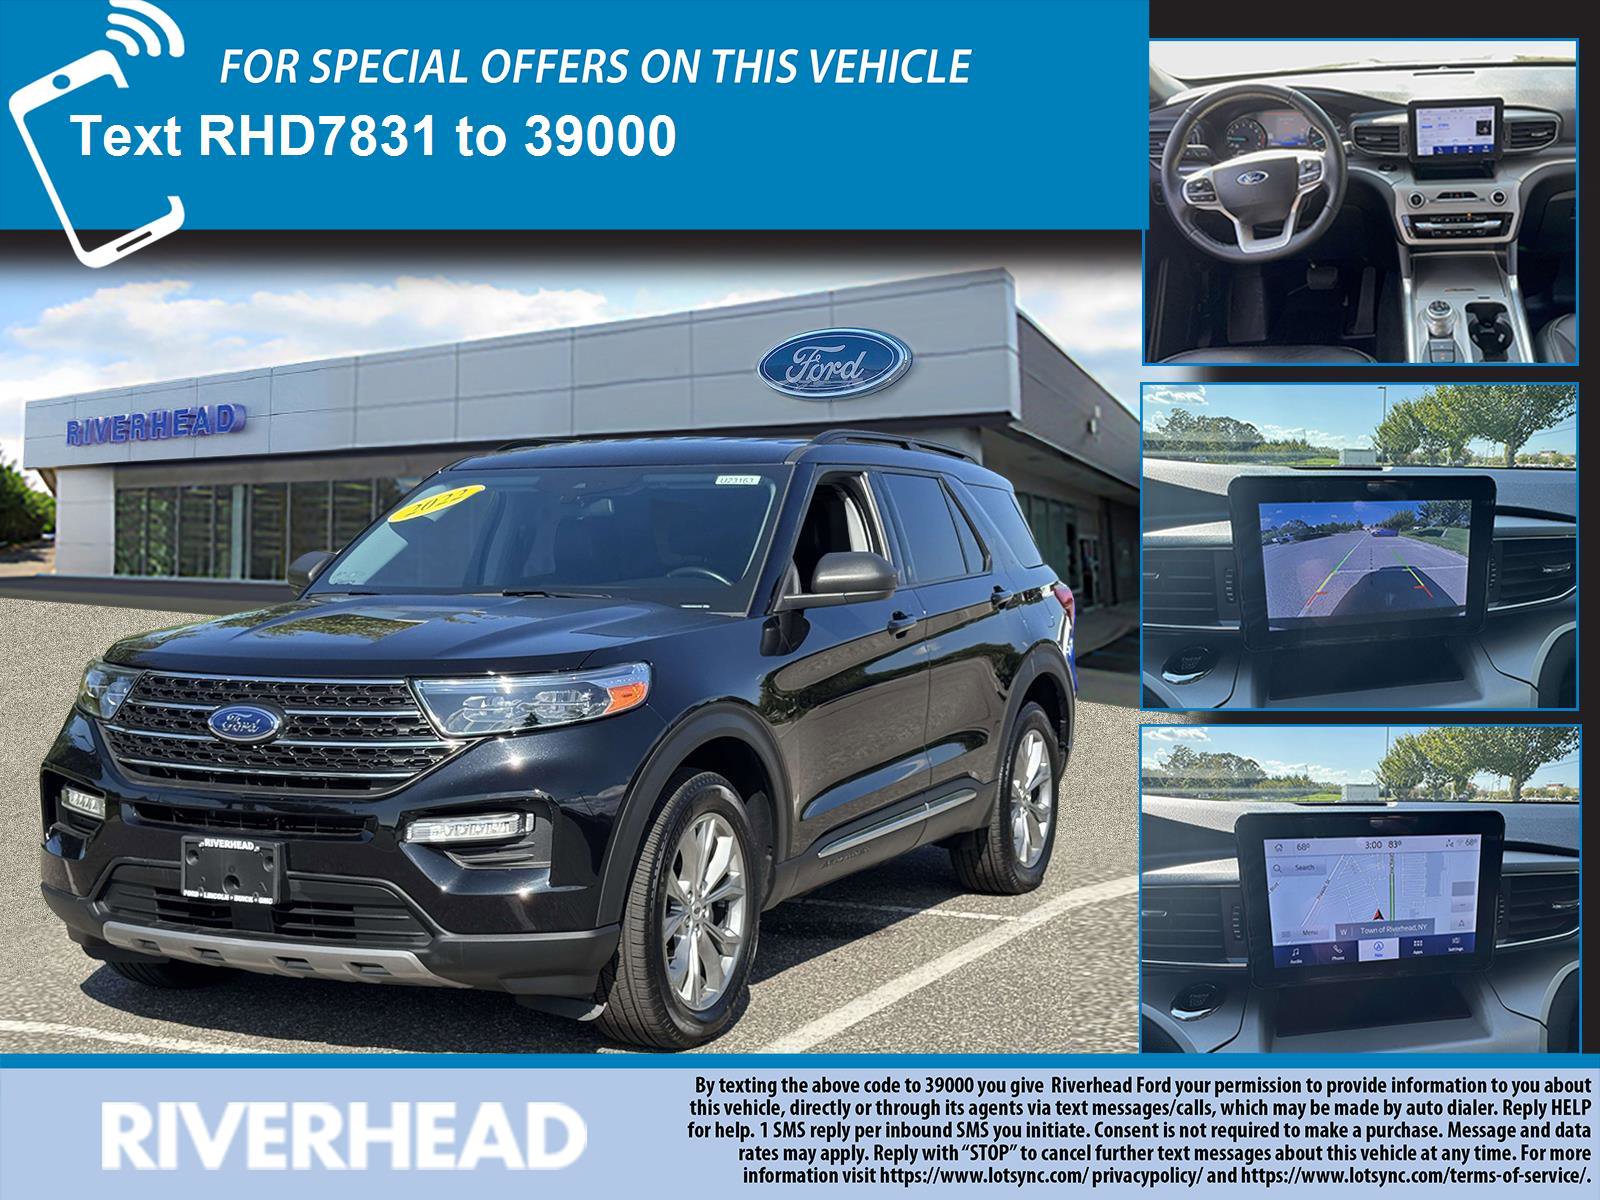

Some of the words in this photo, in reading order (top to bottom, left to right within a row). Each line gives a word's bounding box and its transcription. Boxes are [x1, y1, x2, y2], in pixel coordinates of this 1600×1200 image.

[785, 344, 867, 384] Ford
[66, 403, 247, 447] RIVERHEAD
[405, 488, 469, 517] 2022
[222, 712, 261, 733] Ford
[204, 838, 255, 851] RIVERHEAD
[1364, 840, 1383, 849] 3:00
[1294, 863, 1316, 872] Search
[1339, 928, 1348, 936] W
[1360, 926, 1378, 934] Town
